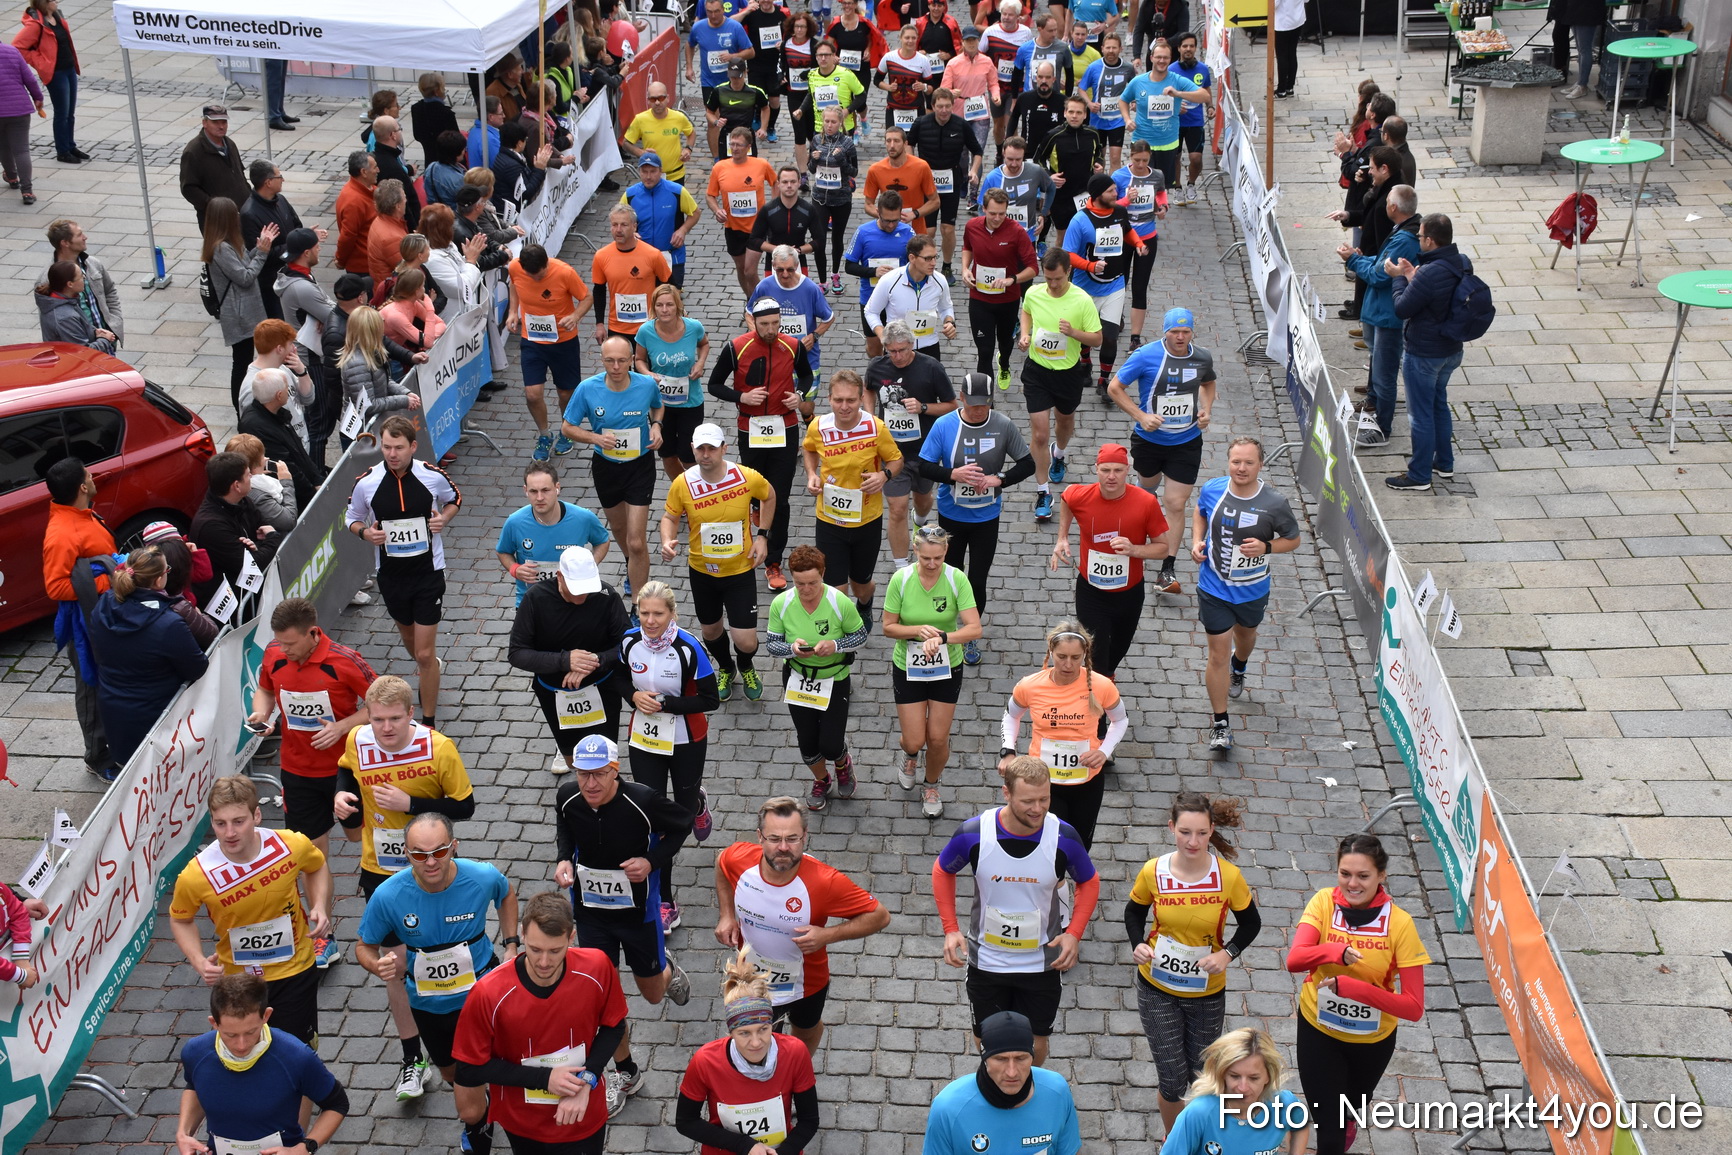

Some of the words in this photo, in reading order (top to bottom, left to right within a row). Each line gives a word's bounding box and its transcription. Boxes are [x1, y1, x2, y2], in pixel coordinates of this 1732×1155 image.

[133, 11, 179, 28] BMW
[185, 15, 323, 38] ConnectedDrive
[136, 29, 190, 45] Vernetzt,
[193, 37, 211, 46] um
[213, 36, 233, 47] frei
[252, 40, 280, 50] sein.
[763, 32, 779, 41] 2518
[842, 56, 858, 64] 2155
[818, 93, 834, 101] 3297
[966, 103, 984, 112] 2039
[1152, 102, 1170, 111] 2200
[897, 115, 914, 123] 2726
[819, 172, 838, 180] 2419
[732, 199, 752, 208] 2091
[1132, 195, 1150, 204] 2067
[1100, 237, 1119, 246] 2152
[620, 302, 641, 312] 2201
[530, 322, 552, 332] 2068
[780, 324, 801, 334] 2563
[915, 319, 927, 328] 74
[1041, 339, 1059, 350] 207
[659, 384, 684, 394] 2074
[1162, 405, 1189, 416] 2017
[345, 413, 357, 433] swn
[888, 419, 914, 430] 2496
[760, 425, 774, 436] 26
[824, 446, 848, 458] MAX
[850, 440, 878, 452] BÖGL
[694, 497, 719, 511] MAX
[721, 486, 750, 502] BÖGL
[831, 496, 853, 509] 267
[389, 529, 419, 543] 2411
[711, 533, 733, 545] 269
[1237, 554, 1265, 568] 2195
[1093, 562, 1123, 576] 2018
[216, 592, 231, 616] swn
[631, 661, 643, 670] tkn
[912, 652, 943, 666] 2344
[798, 678, 821, 693] 154
[797, 693, 818, 702] Christine
[288, 703, 325, 717] 2223
[566, 700, 592, 714] 403
[1041, 712, 1085, 721] Atzenhofer
[643, 722, 659, 737] 34
[1052, 753, 1078, 768] 119
[361, 771, 394, 786] MAX
[397, 765, 437, 781] BÖGL
[28, 862, 49, 888] swn
[65, 827, 118, 931] UNS
[1003, 876, 1040, 884] KLEBL
[220, 883, 257, 908] MAX
[258, 861, 298, 887] BÖGL
[586, 879, 624, 894] 2174
[1159, 897, 1186, 906] MAX
[1190, 895, 1223, 905] BÖGL
[445, 912, 475, 923] BOCK
[778, 914, 803, 923] KOPPE
[1001, 924, 1019, 938] 21
[239, 931, 284, 950] 2627
[1326, 932, 1352, 947] MAX
[1356, 938, 1389, 950] BÖGL
[426, 962, 459, 979] 203
[1159, 954, 1201, 976] 2634
[84, 952, 135, 1035] Service-Line:
[1533, 977, 1557, 1025] Neumarkts
[1326, 1000, 1371, 1019] 2635
[735, 1117, 770, 1136] 124
[1022, 1133, 1053, 1146] BOCK
